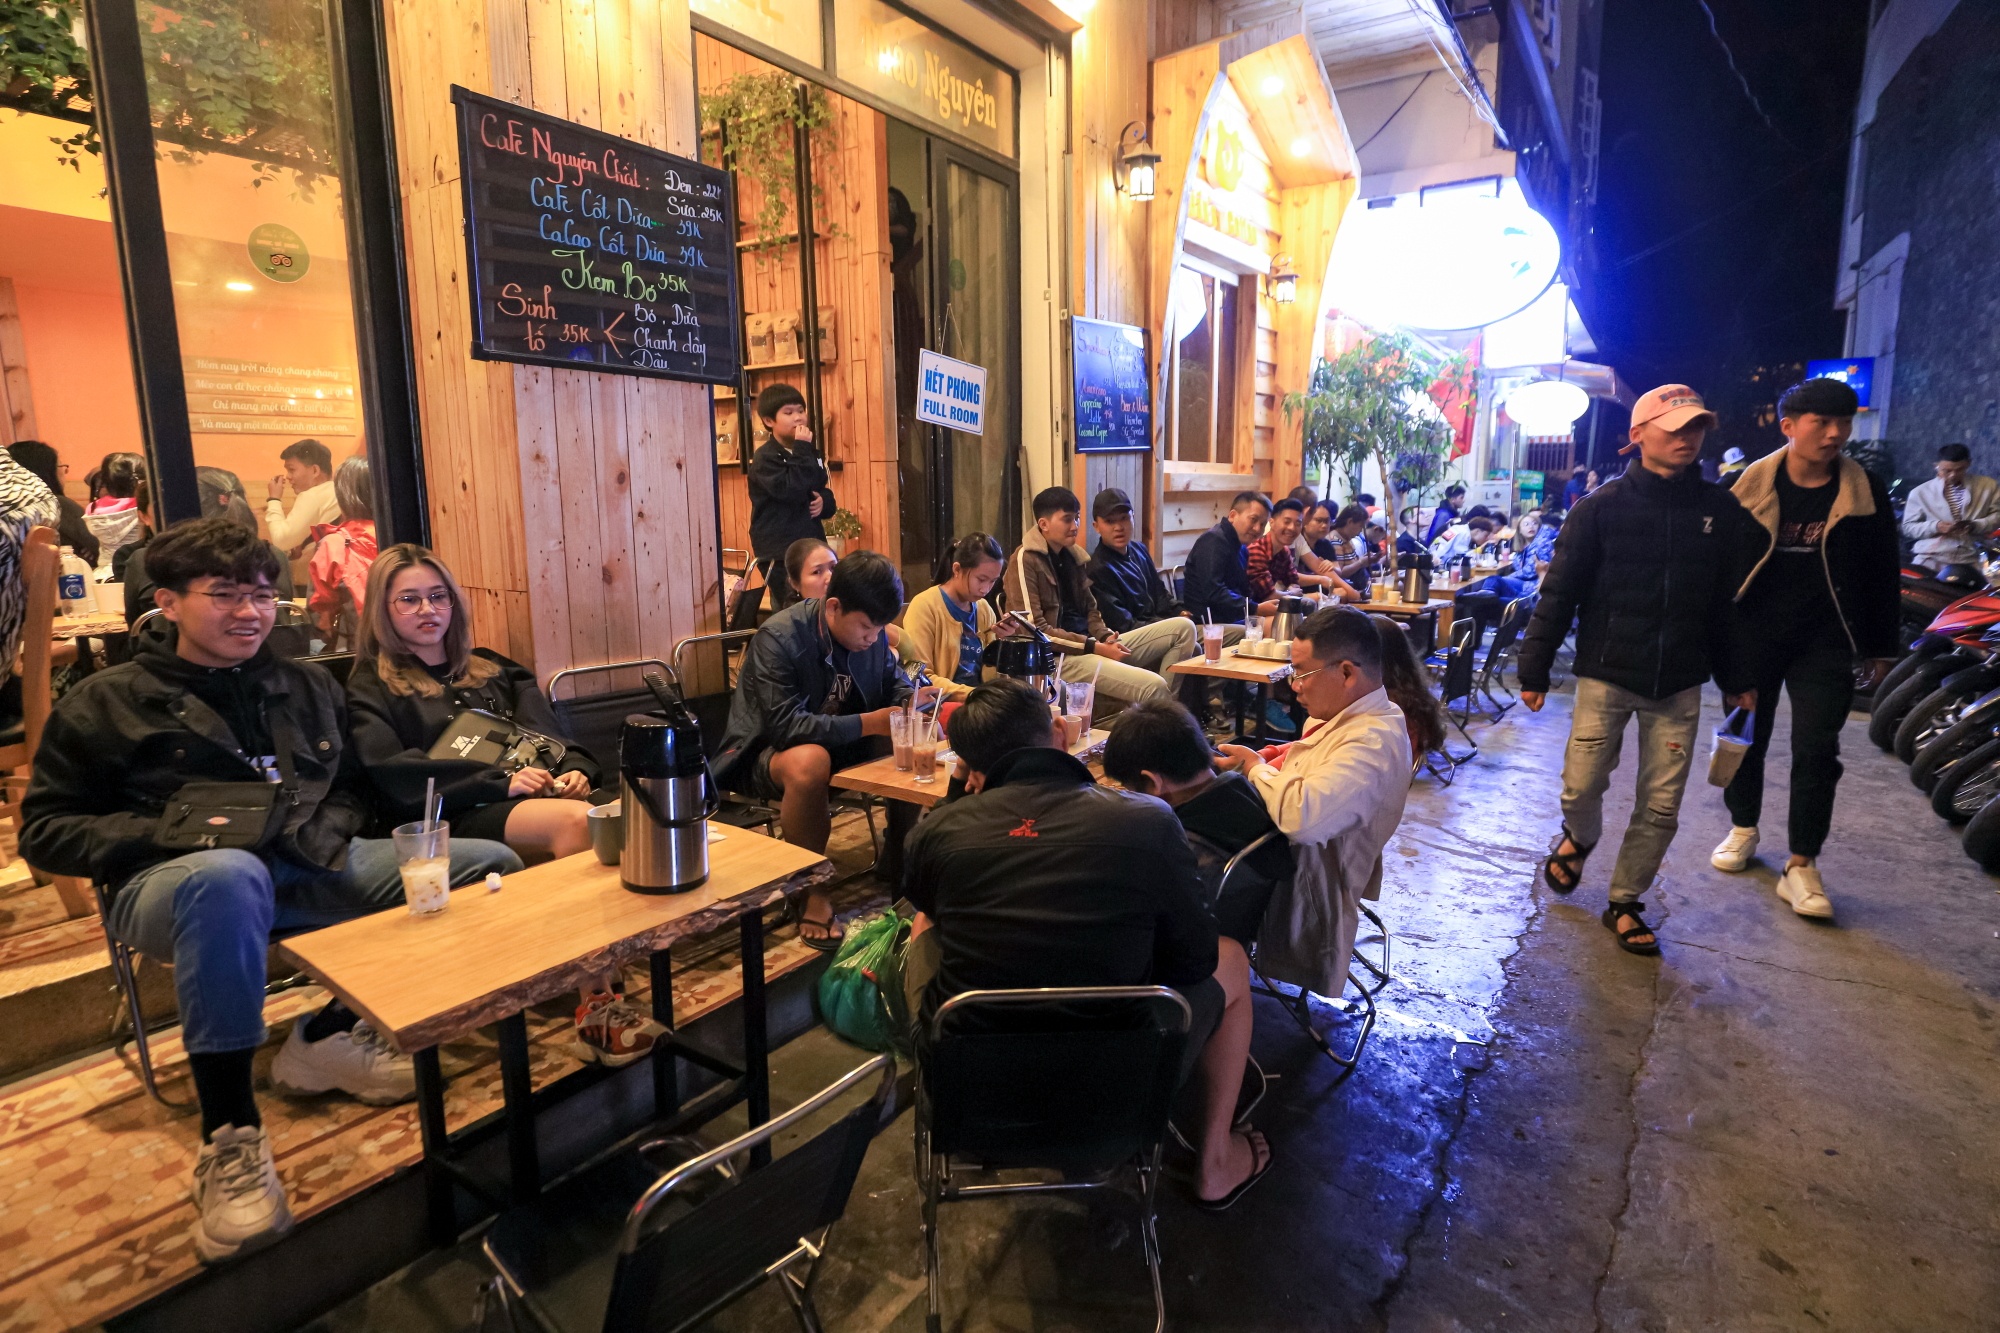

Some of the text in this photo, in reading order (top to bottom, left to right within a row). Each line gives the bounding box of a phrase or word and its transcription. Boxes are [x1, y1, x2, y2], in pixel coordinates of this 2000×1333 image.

[924, 49, 996, 129] Nguyên
[533, 128, 599, 187] Nguyên
[701, 207, 724, 224] 25K
[676, 219, 704, 239] 39K
[679, 246, 708, 268] 39K
[657, 272, 691, 294] 35K
[497, 283, 558, 320] Sinh
[559, 323, 592, 343] 35K
[634, 327, 707, 367] Chanh dây
[220, 363, 239, 375] nay
[285, 365, 313, 378] chang
[313, 367, 339, 380] chang
[216, 382, 233, 390] con
[925, 364, 980, 405] HẾT PHÒNG
[231, 402, 258, 412] mang
[924, 399, 978, 426] FULL ROOM
[216, 421, 241, 432] mang
[318, 424, 334, 432] con
[334, 424, 348, 432] con
